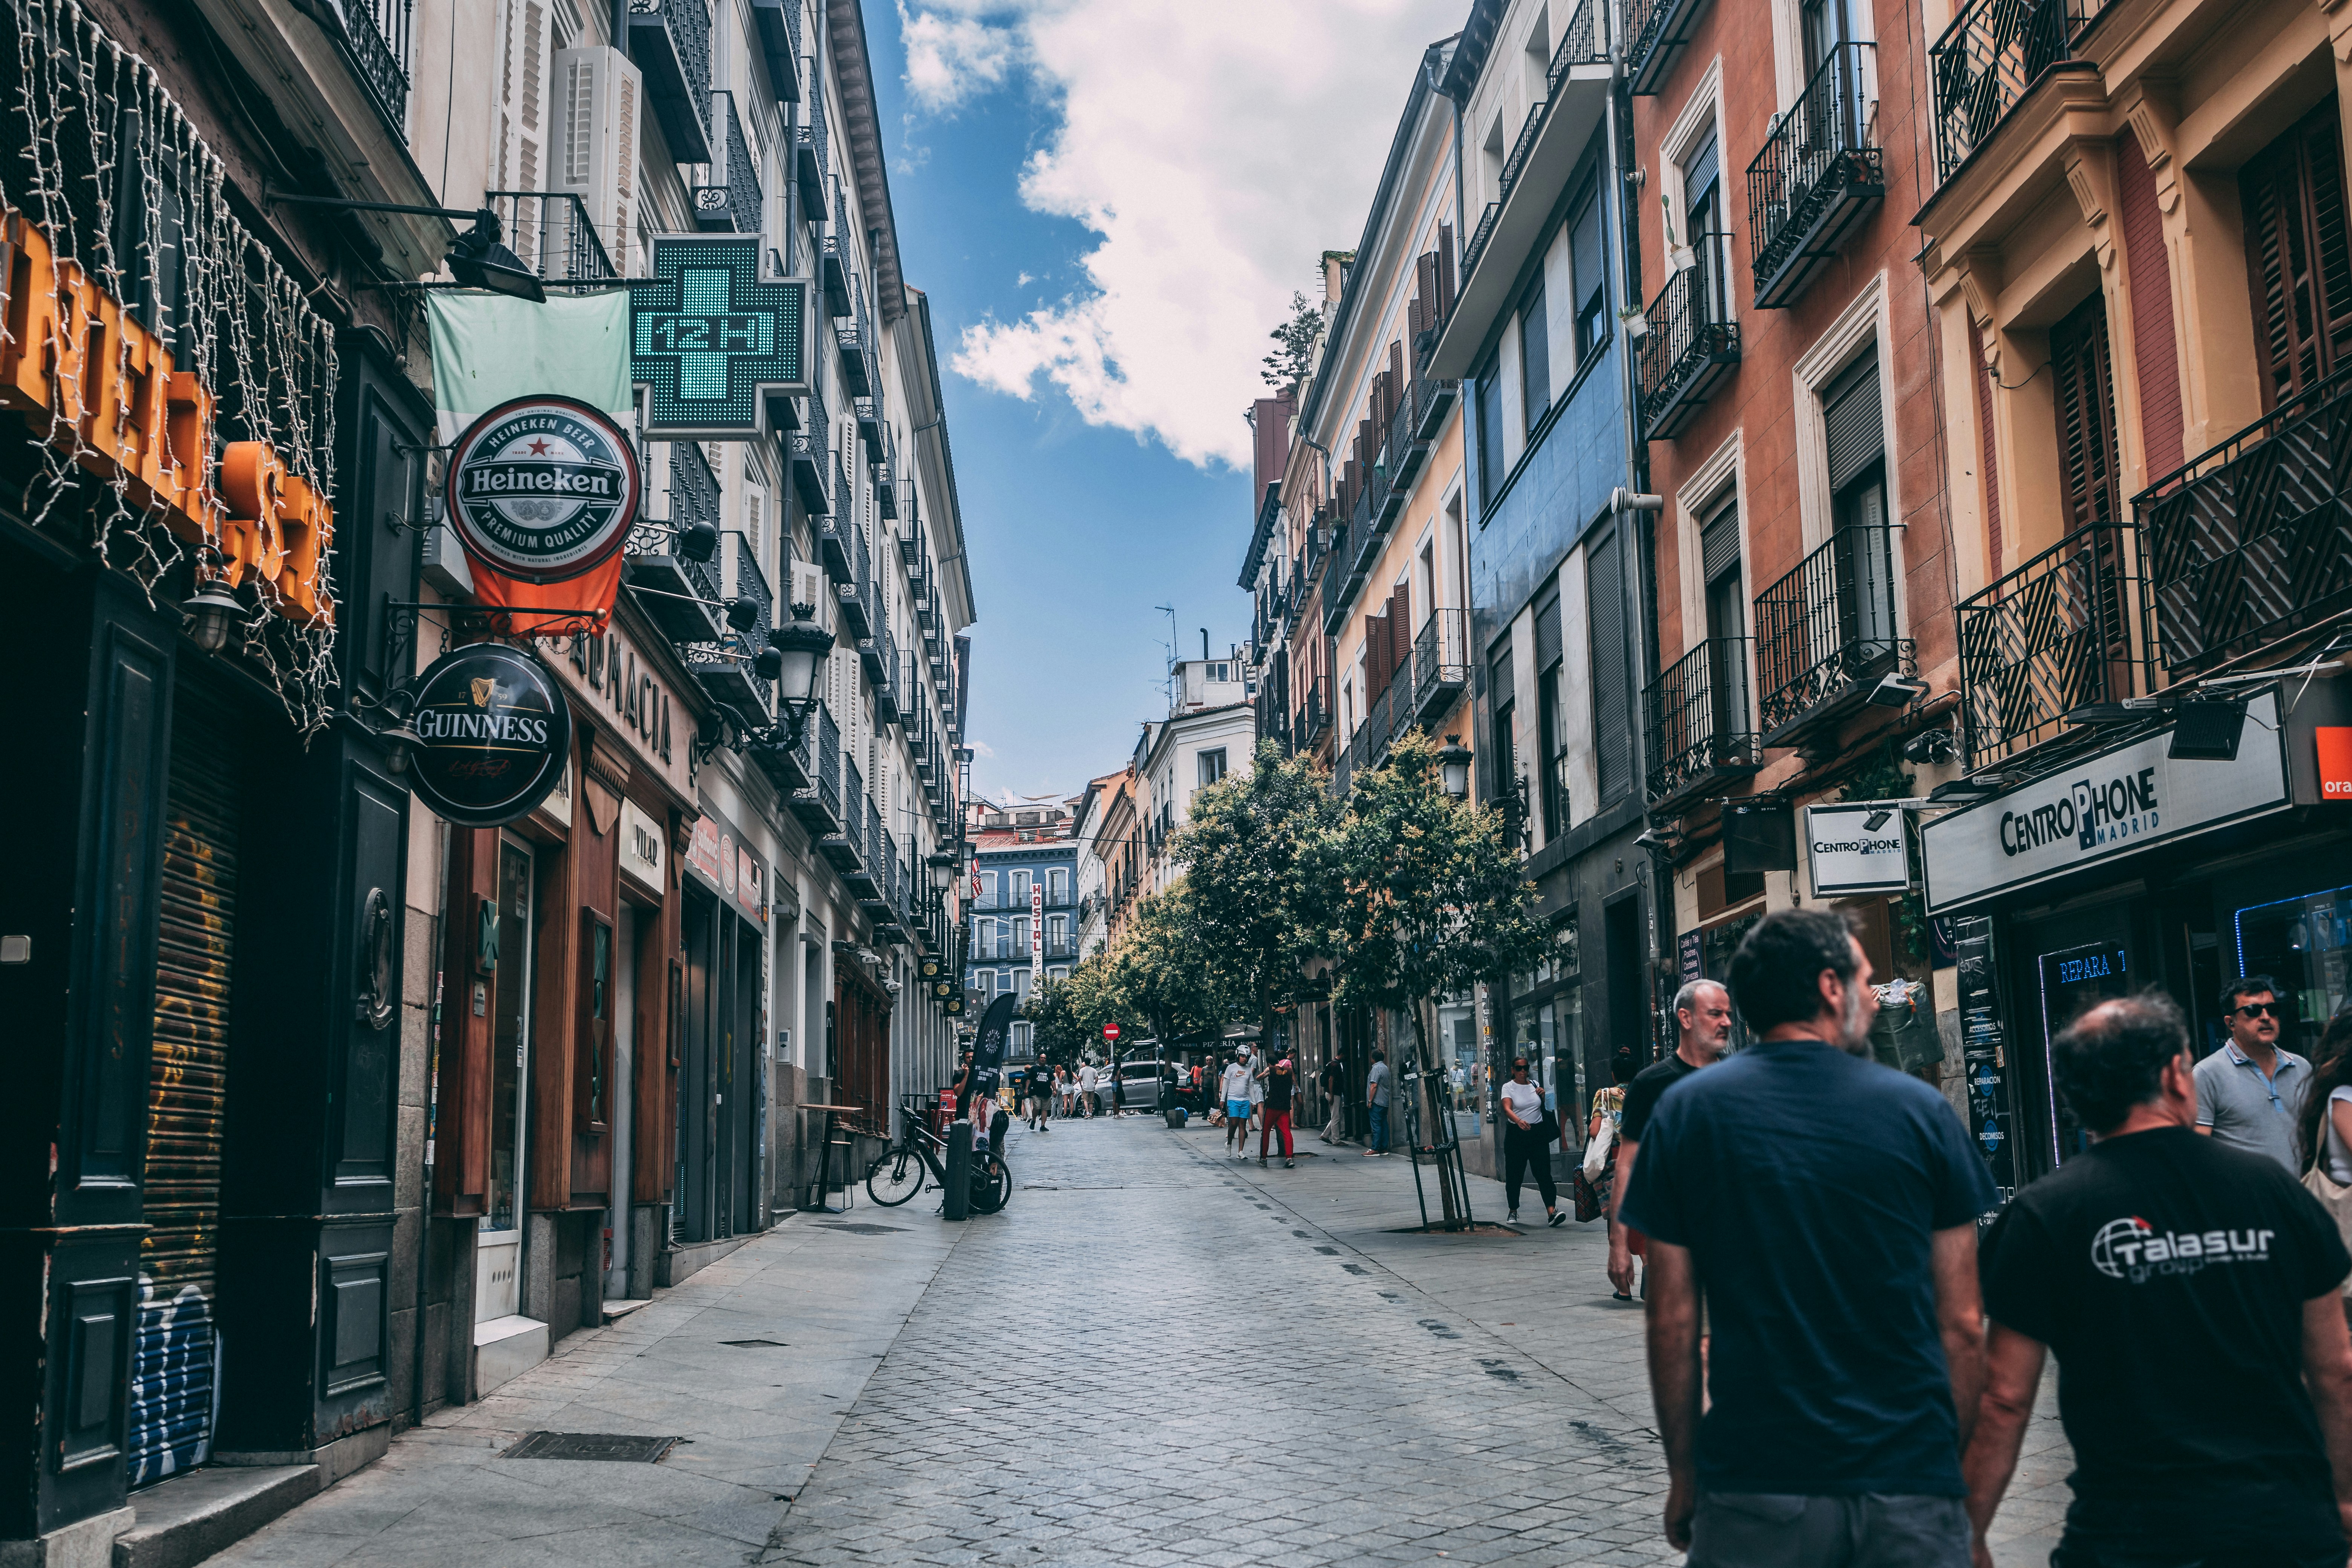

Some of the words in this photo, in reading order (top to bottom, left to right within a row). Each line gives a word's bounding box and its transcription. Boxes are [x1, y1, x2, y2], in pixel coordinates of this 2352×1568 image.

[655, 319, 709, 349] 12
[720, 319, 755, 349] H
[555, 410, 578, 419] QUALITY
[488, 418, 558, 448] HEINEKEN
[562, 423, 596, 449] BEER
[472, 467, 610, 494] Heineken
[481, 511, 538, 548] PREMIUM
[545, 511, 598, 548] QUALITY
[492, 544, 510, 557] BREWED
[554, 544, 588, 562] INGREDIENTS
[552, 630, 672, 765] ARMACIA
[416, 709, 547, 744] GUINNESS
[2097, 812, 2159, 845] MADRID
[633, 824, 657, 868] VILAR
[698, 828, 718, 861] solfonic
[1033, 884, 1041, 951] HOSTAL
[1680, 938, 1689, 948] Cafés
[1690, 938, 1692, 947] y
[1684, 949, 1696, 959] Postres
[1683, 971, 1698, 982] Cervezas
[2060, 954, 2111, 983] REPARA
[1969, 1022, 1996, 1033] ACCESORIOS
[1974, 1073, 2000, 1086] REPARACIÓN
[1979, 1132, 2004, 1141] DECOMISOS
[2114, 1228, 2275, 1266] Talasur
